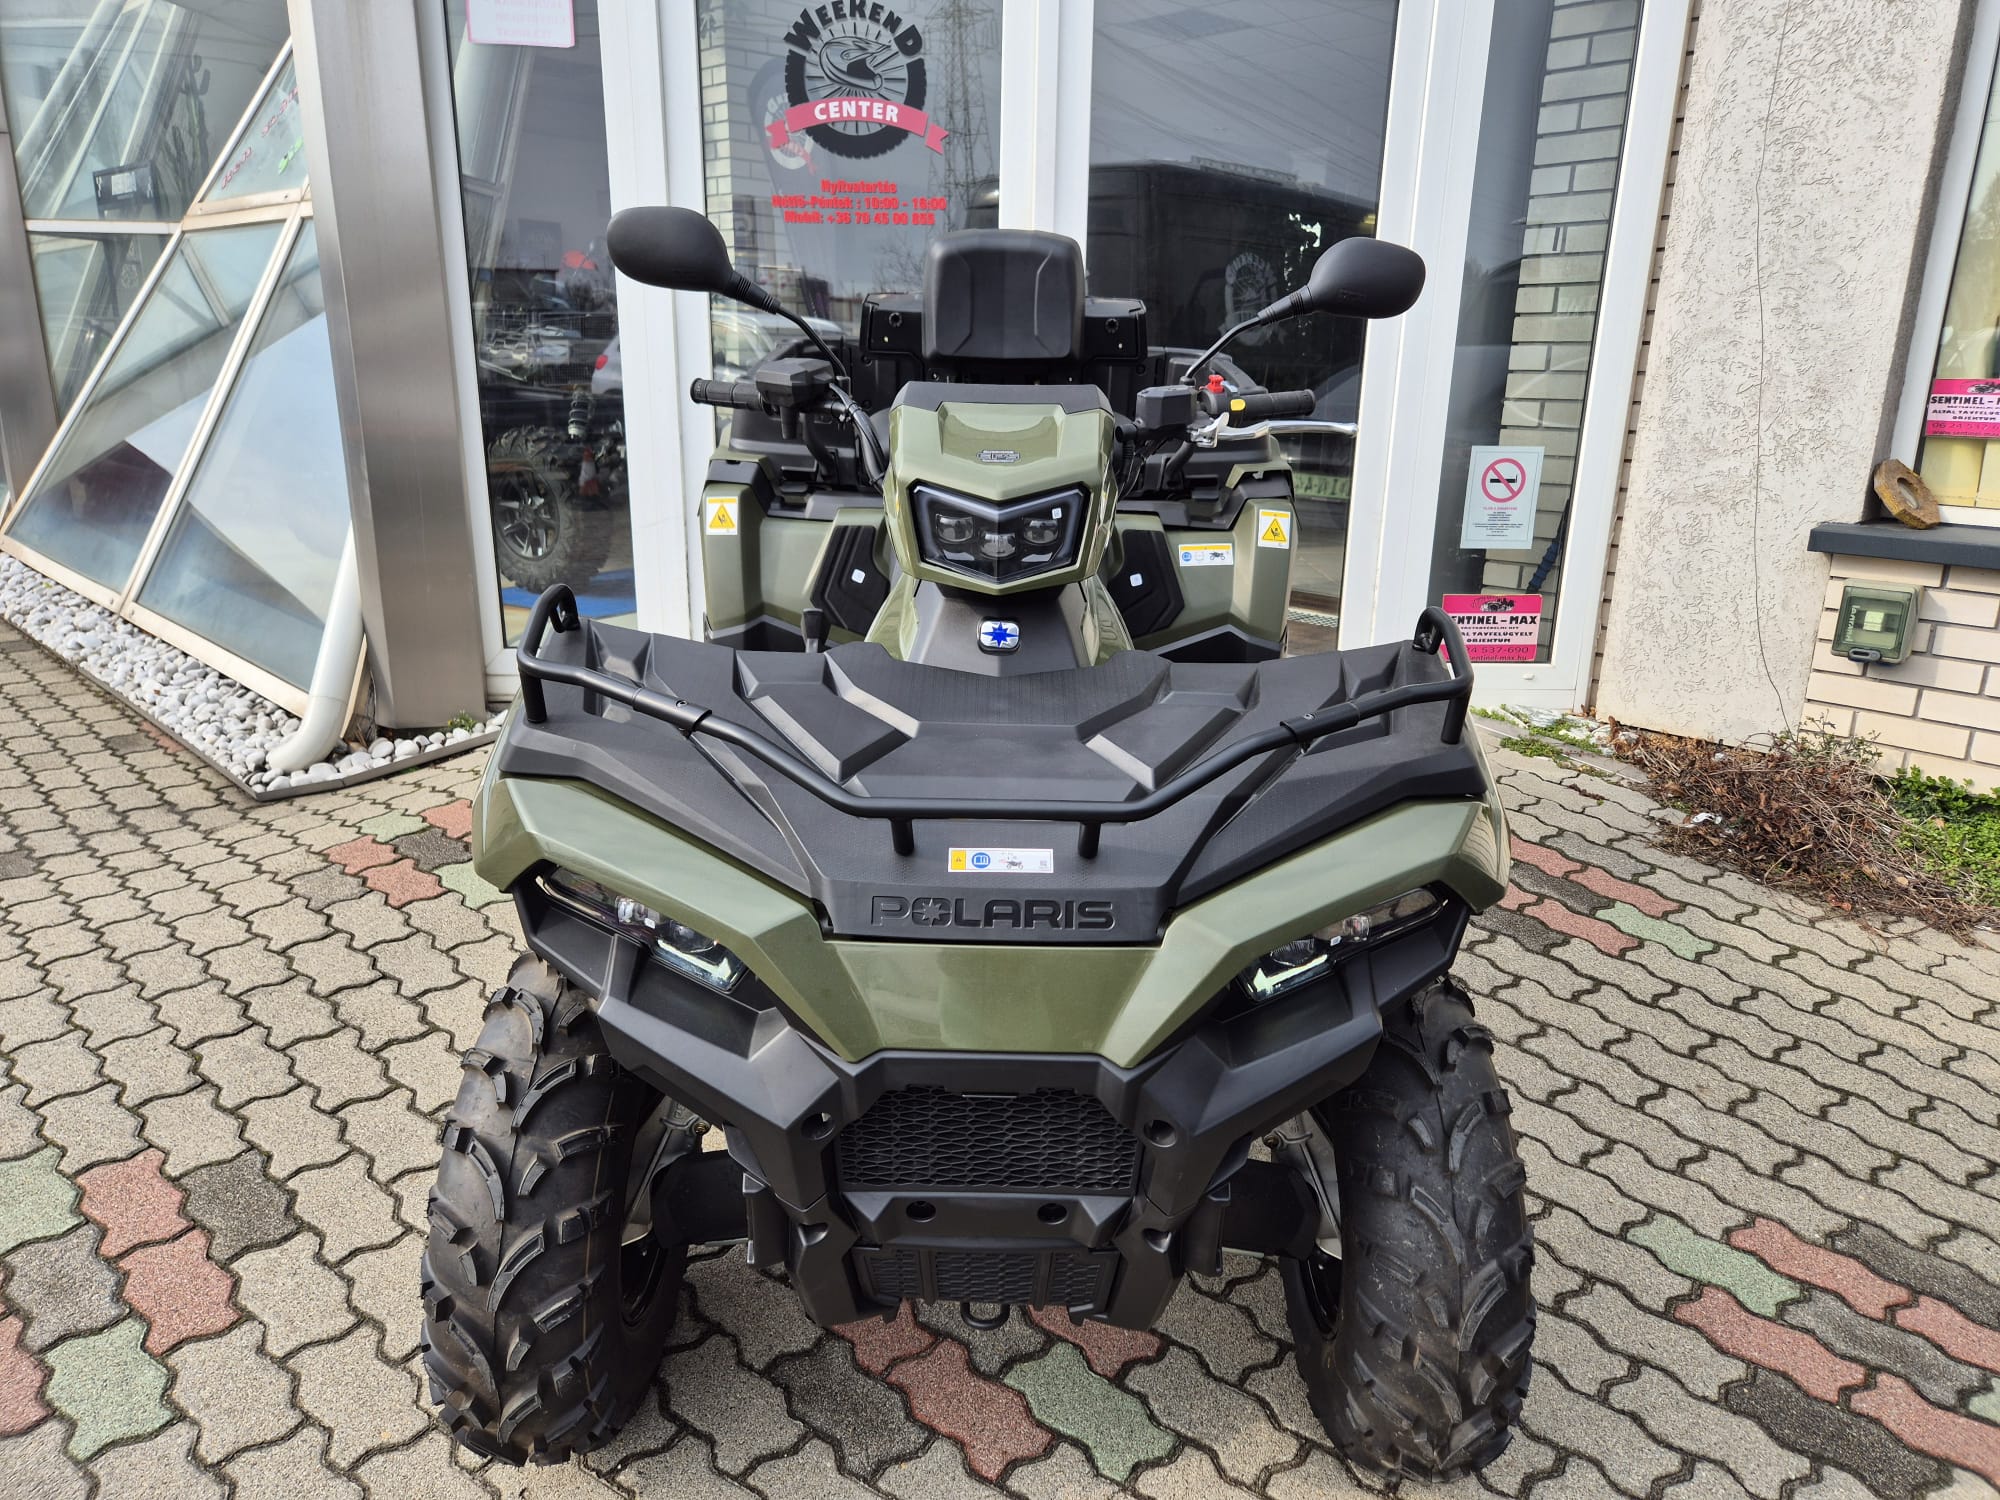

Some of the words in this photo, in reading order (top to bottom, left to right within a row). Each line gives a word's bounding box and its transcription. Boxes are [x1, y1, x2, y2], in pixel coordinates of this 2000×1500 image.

[783, 0, 923, 56] WEEKEND
[814, 100, 899, 123] CENTER
[865, 197, 899, 210] 10:00
[826, 211, 852, 225] +36
[855, 211, 870, 225] 70
[873, 211, 890, 225] 45
[1930, 396, 1985, 405] SENTINEL
[1452, 615, 1499, 625] NTINEL
[1509, 615, 1538, 625] MAX
[871, 895, 1116, 930] POLARIS
